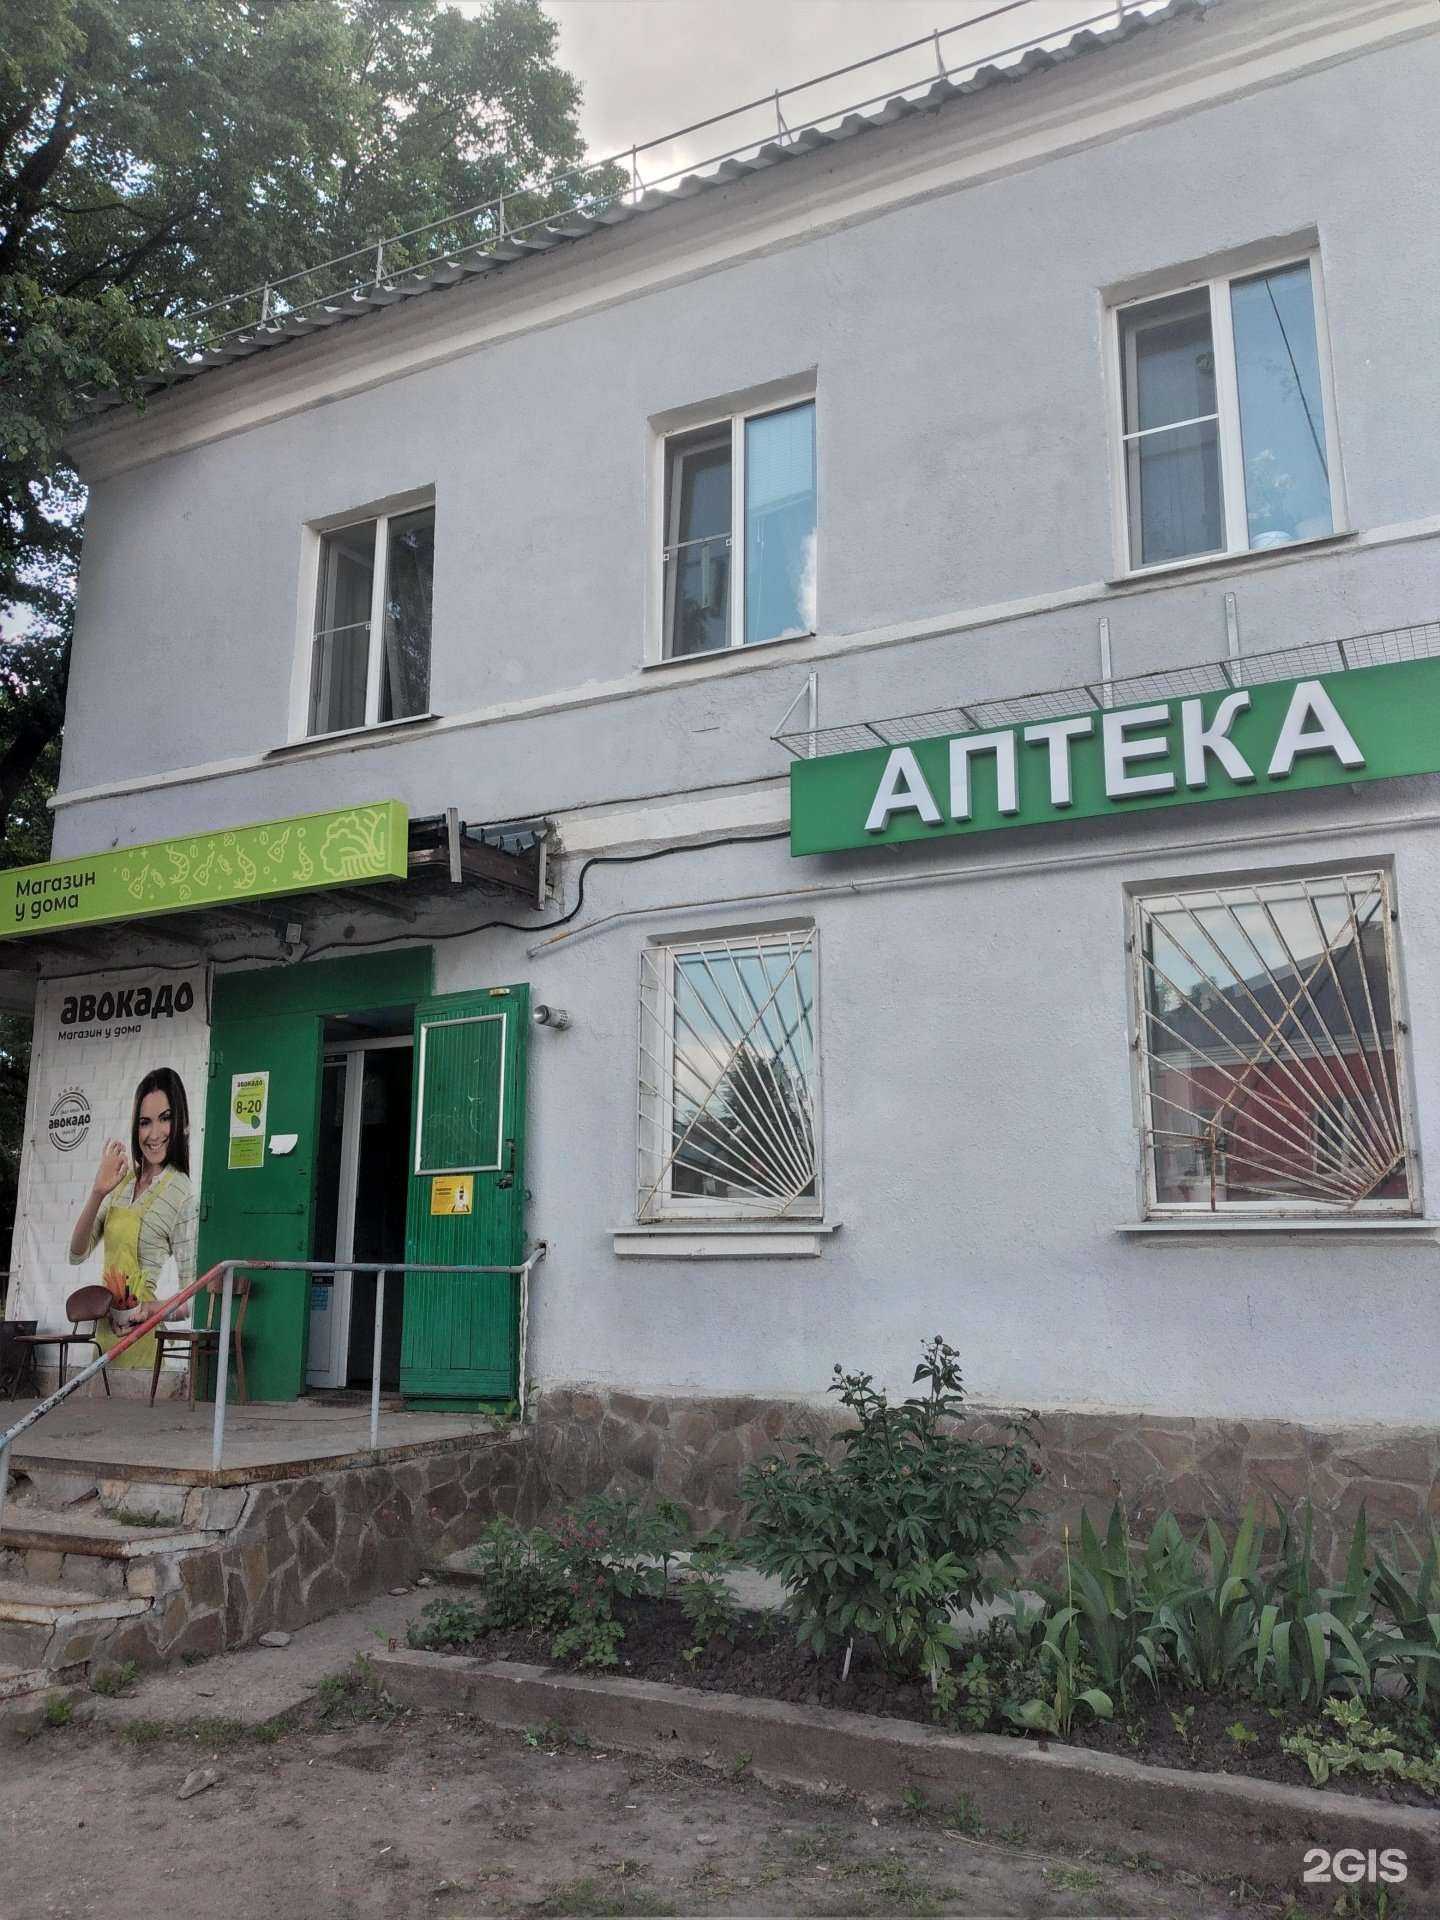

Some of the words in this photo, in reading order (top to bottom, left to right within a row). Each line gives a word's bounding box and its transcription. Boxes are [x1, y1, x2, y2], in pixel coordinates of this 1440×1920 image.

[864, 679, 1367, 834] АПТЕКА
[15, 871, 96, 898] Магазин
[15, 903, 25, 922] у
[31, 894, 79, 919] дома
[60, 981, 194, 1024] авокадо
[57, 1028, 102, 1041] Магазин
[105, 1028, 112, 1038] у
[114, 1024, 142, 1038] дома
[236, 1099, 262, 1114] 8-20
[48, 1113, 91, 1130] авокадо
